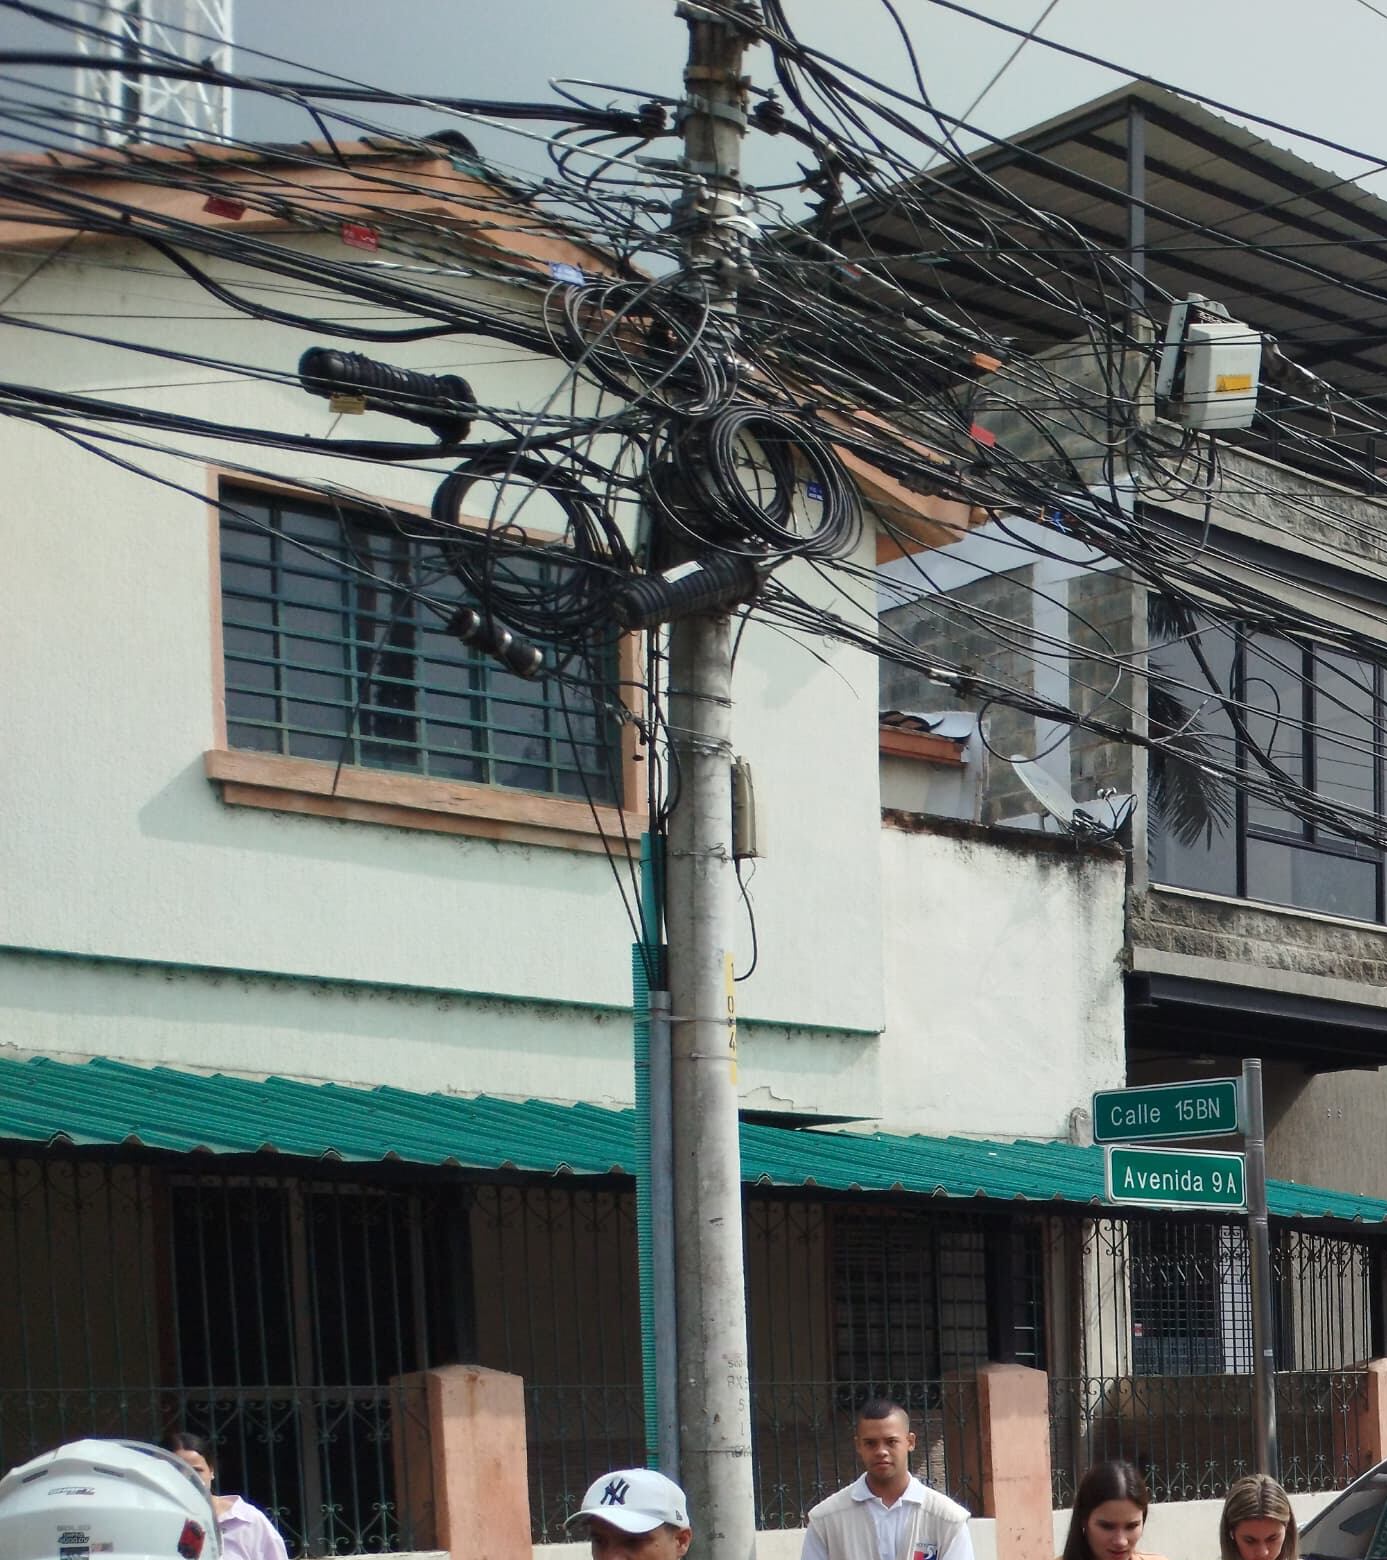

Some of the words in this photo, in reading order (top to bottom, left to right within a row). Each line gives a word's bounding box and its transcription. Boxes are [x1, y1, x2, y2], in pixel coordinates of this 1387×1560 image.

[1111, 1104, 1160, 1126] Calle
[1175, 1097, 1220, 1121] 15BN
[1124, 1166, 1203, 1191] Avenida
